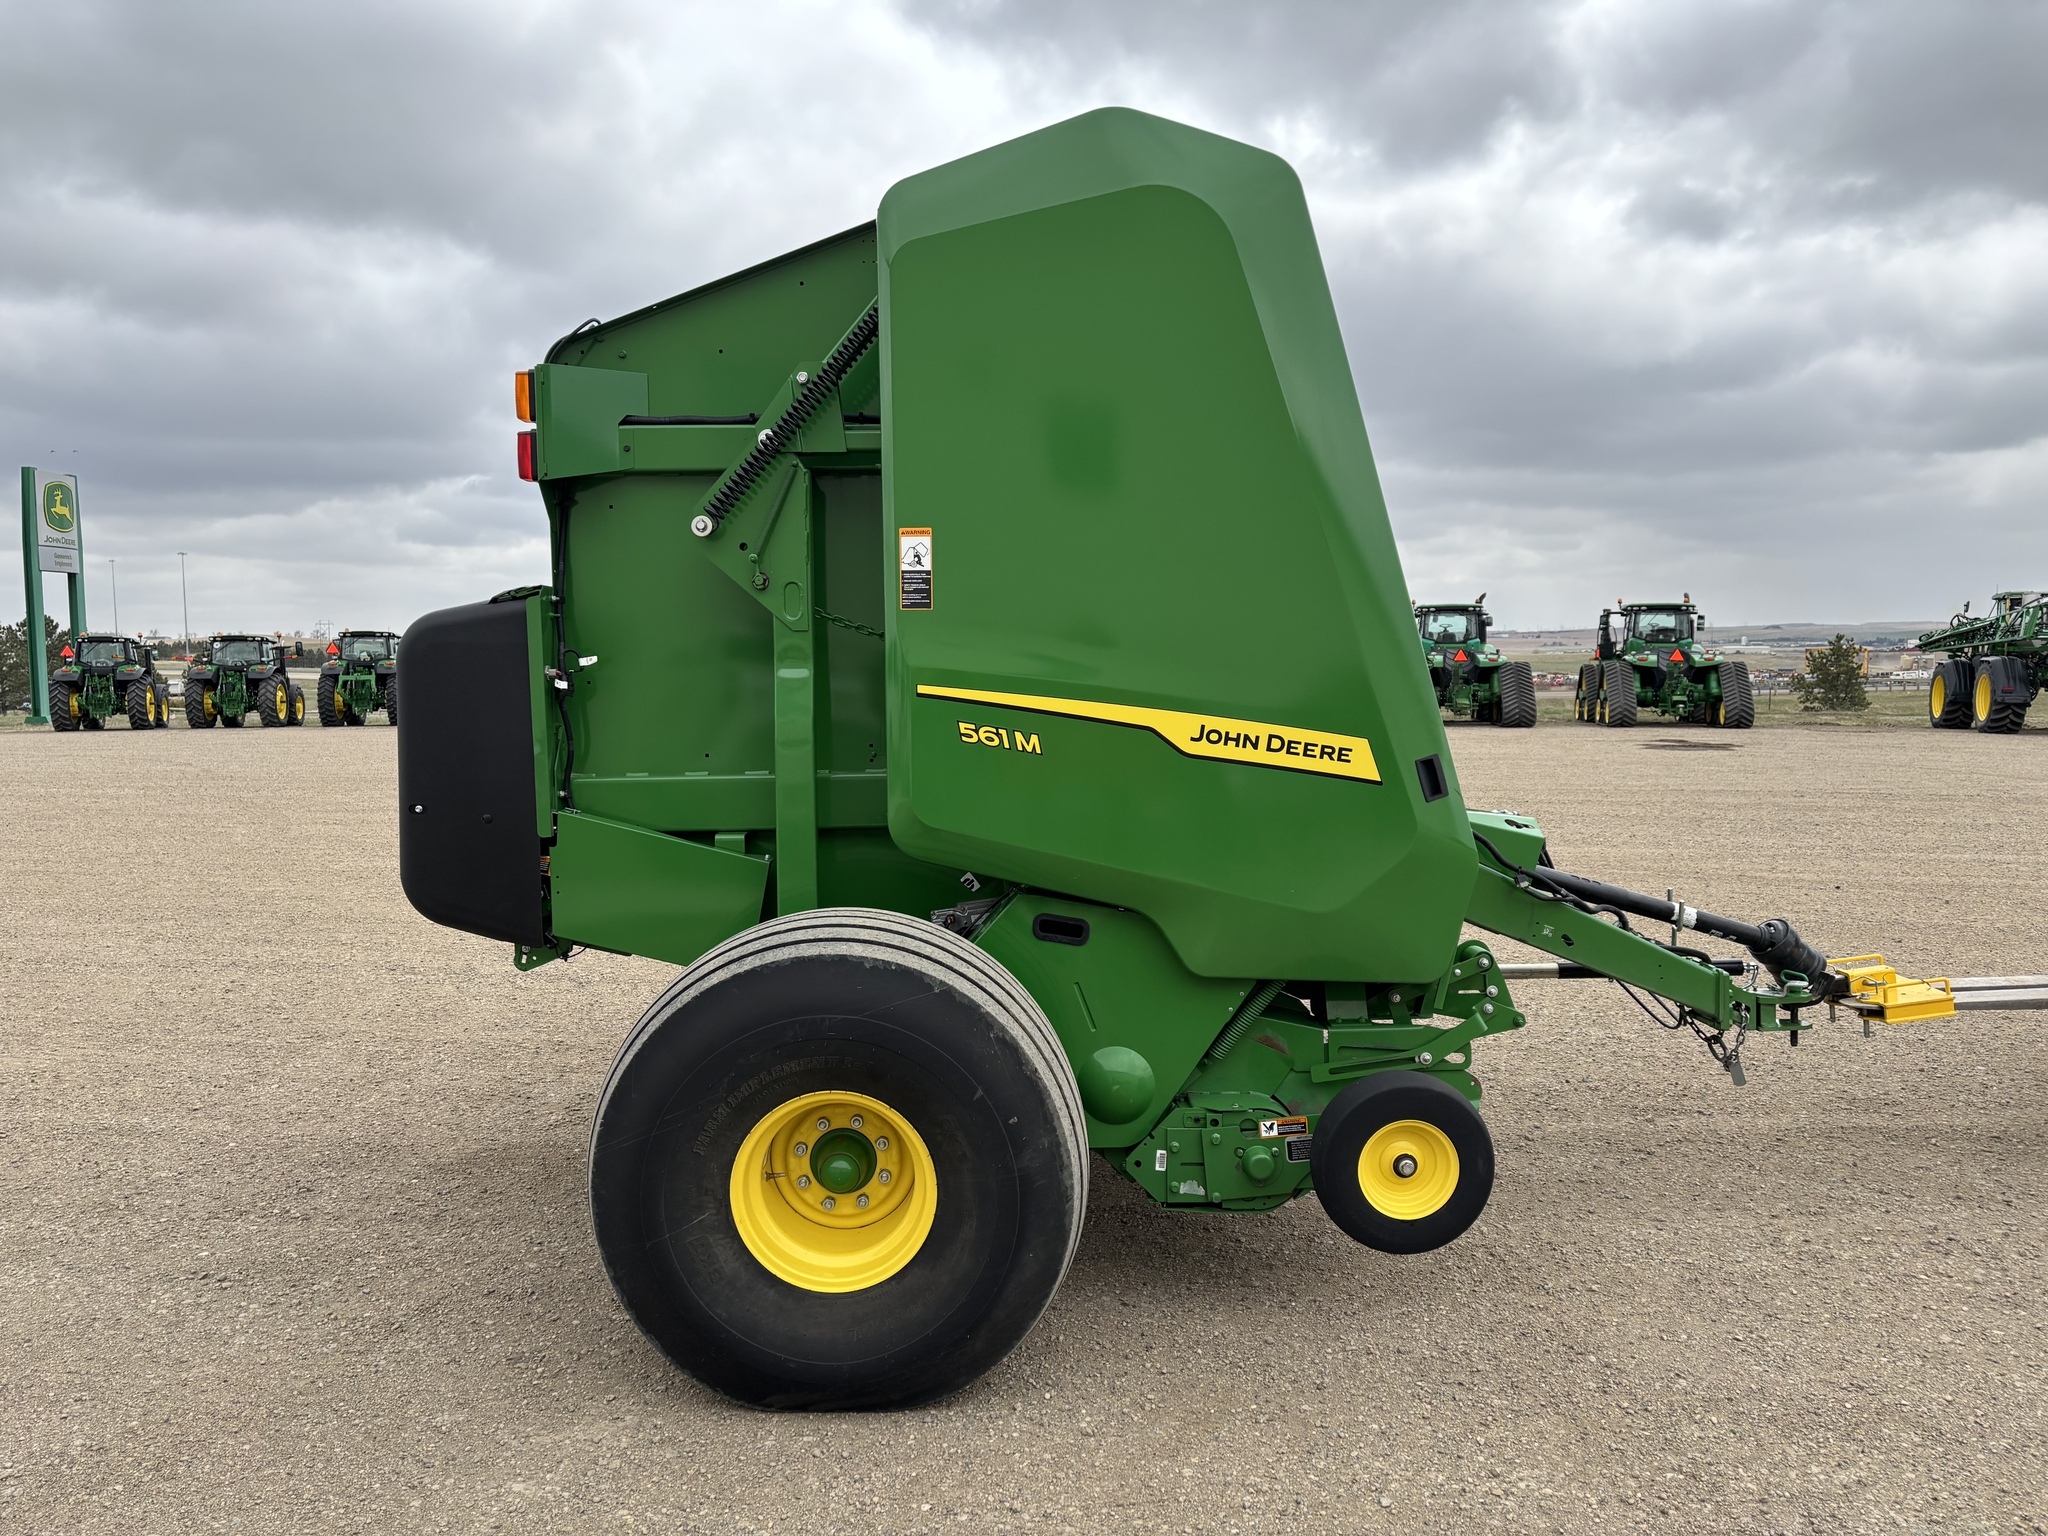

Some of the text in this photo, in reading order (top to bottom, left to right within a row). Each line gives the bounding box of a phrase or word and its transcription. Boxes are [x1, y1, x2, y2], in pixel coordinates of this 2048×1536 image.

[44, 535, 76, 546] JOHN DEERE
[958, 721, 1042, 755] 561 M
[1190, 724, 1353, 763] JOHN DEERE
[692, 1103, 730, 1156] FARM
[726, 1056, 839, 1108] IMPLEMENT
